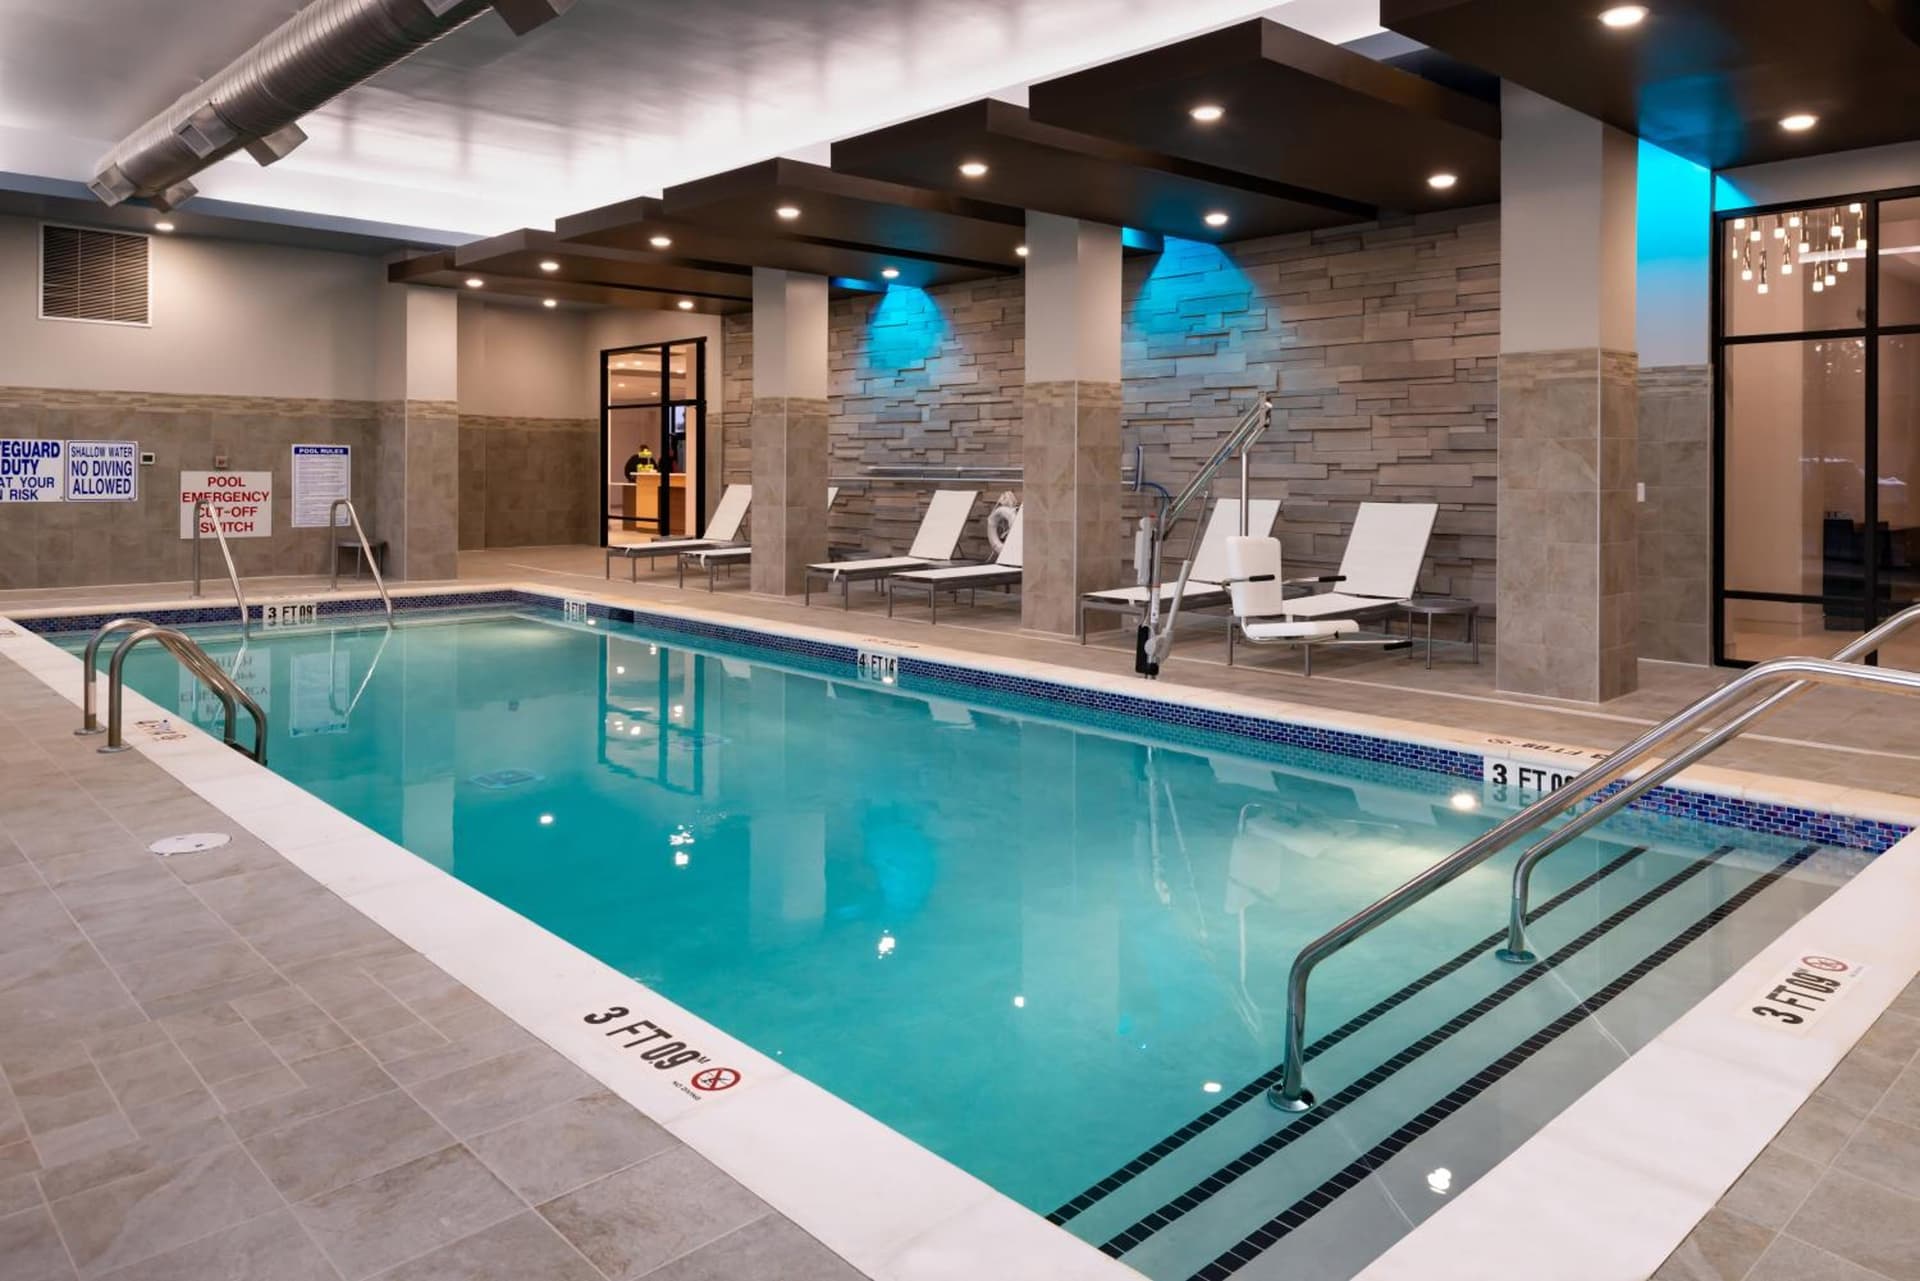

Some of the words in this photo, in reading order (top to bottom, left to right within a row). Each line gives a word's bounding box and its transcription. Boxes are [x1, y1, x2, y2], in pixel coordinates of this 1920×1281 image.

[0, 441, 60, 458] EGUARD
[71, 446, 105, 457] SHALLOW
[108, 447, 132, 457] WATER
[1, 459, 39, 475] DUTY
[71, 460, 88, 476] NO
[93, 460, 132, 476] DIVING
[20, 477, 54, 488] YOUR
[72, 478, 131, 494] ALLOWED
[208, 476, 246, 487] POOL
[10, 489, 38, 500] RISK
[182, 491, 269, 502] EMERGENCY
[268, 607, 276, 618] 3
[1492, 763, 1508, 785] 3
[584, 1006, 629, 1025] 3
[1752, 1006, 1804, 1025] 3
